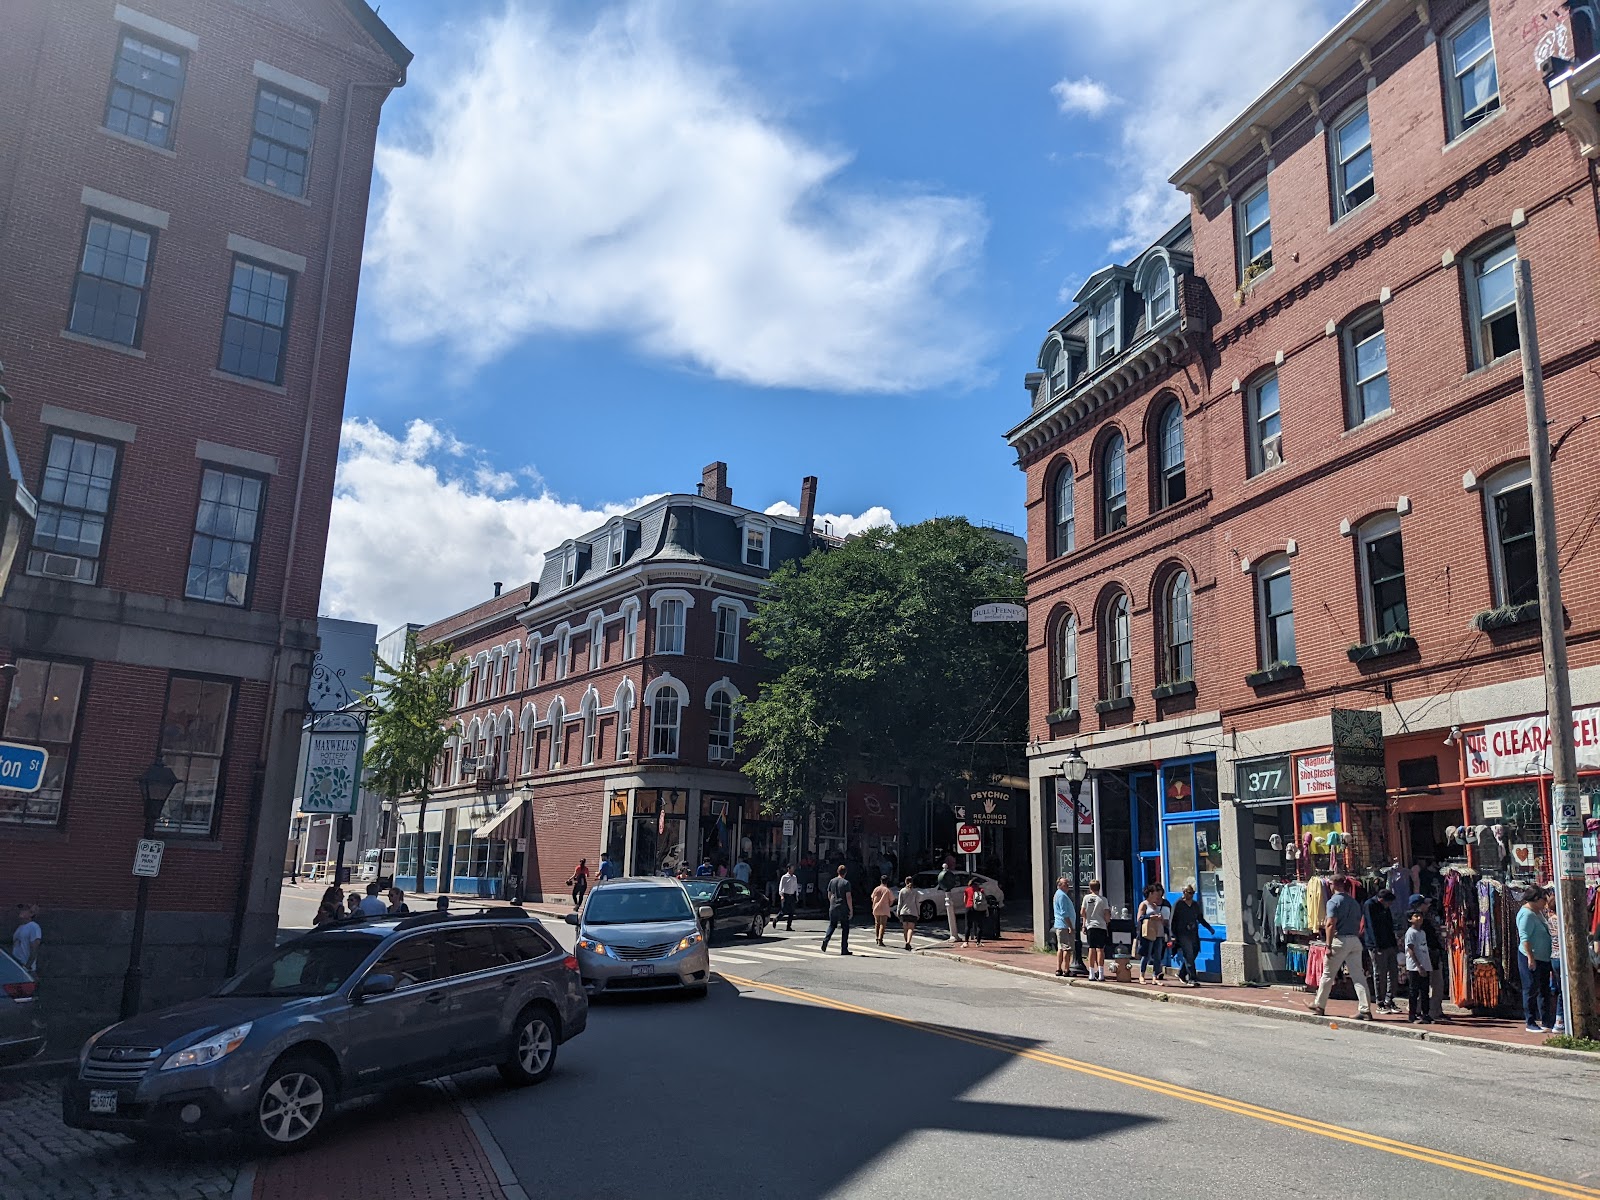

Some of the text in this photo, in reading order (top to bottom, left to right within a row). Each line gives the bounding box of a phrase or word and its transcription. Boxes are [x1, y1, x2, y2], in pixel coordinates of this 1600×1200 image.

[1492, 717, 1599, 757] CLEARACE!
[314, 739, 358, 752] MAXWELL'S
[30, 759, 40, 771] St
[1304, 755, 1331, 767] Magnets
[1248, 769, 1282, 792] 377
[1300, 770, 1314, 780] Shot
[1306, 781, 1332, 792] T-Shirts
[970, 791, 1009, 800] PSYCHIC
[1560, 838, 1567, 847] 15
[1063, 853, 1093, 867] PSCHIC
